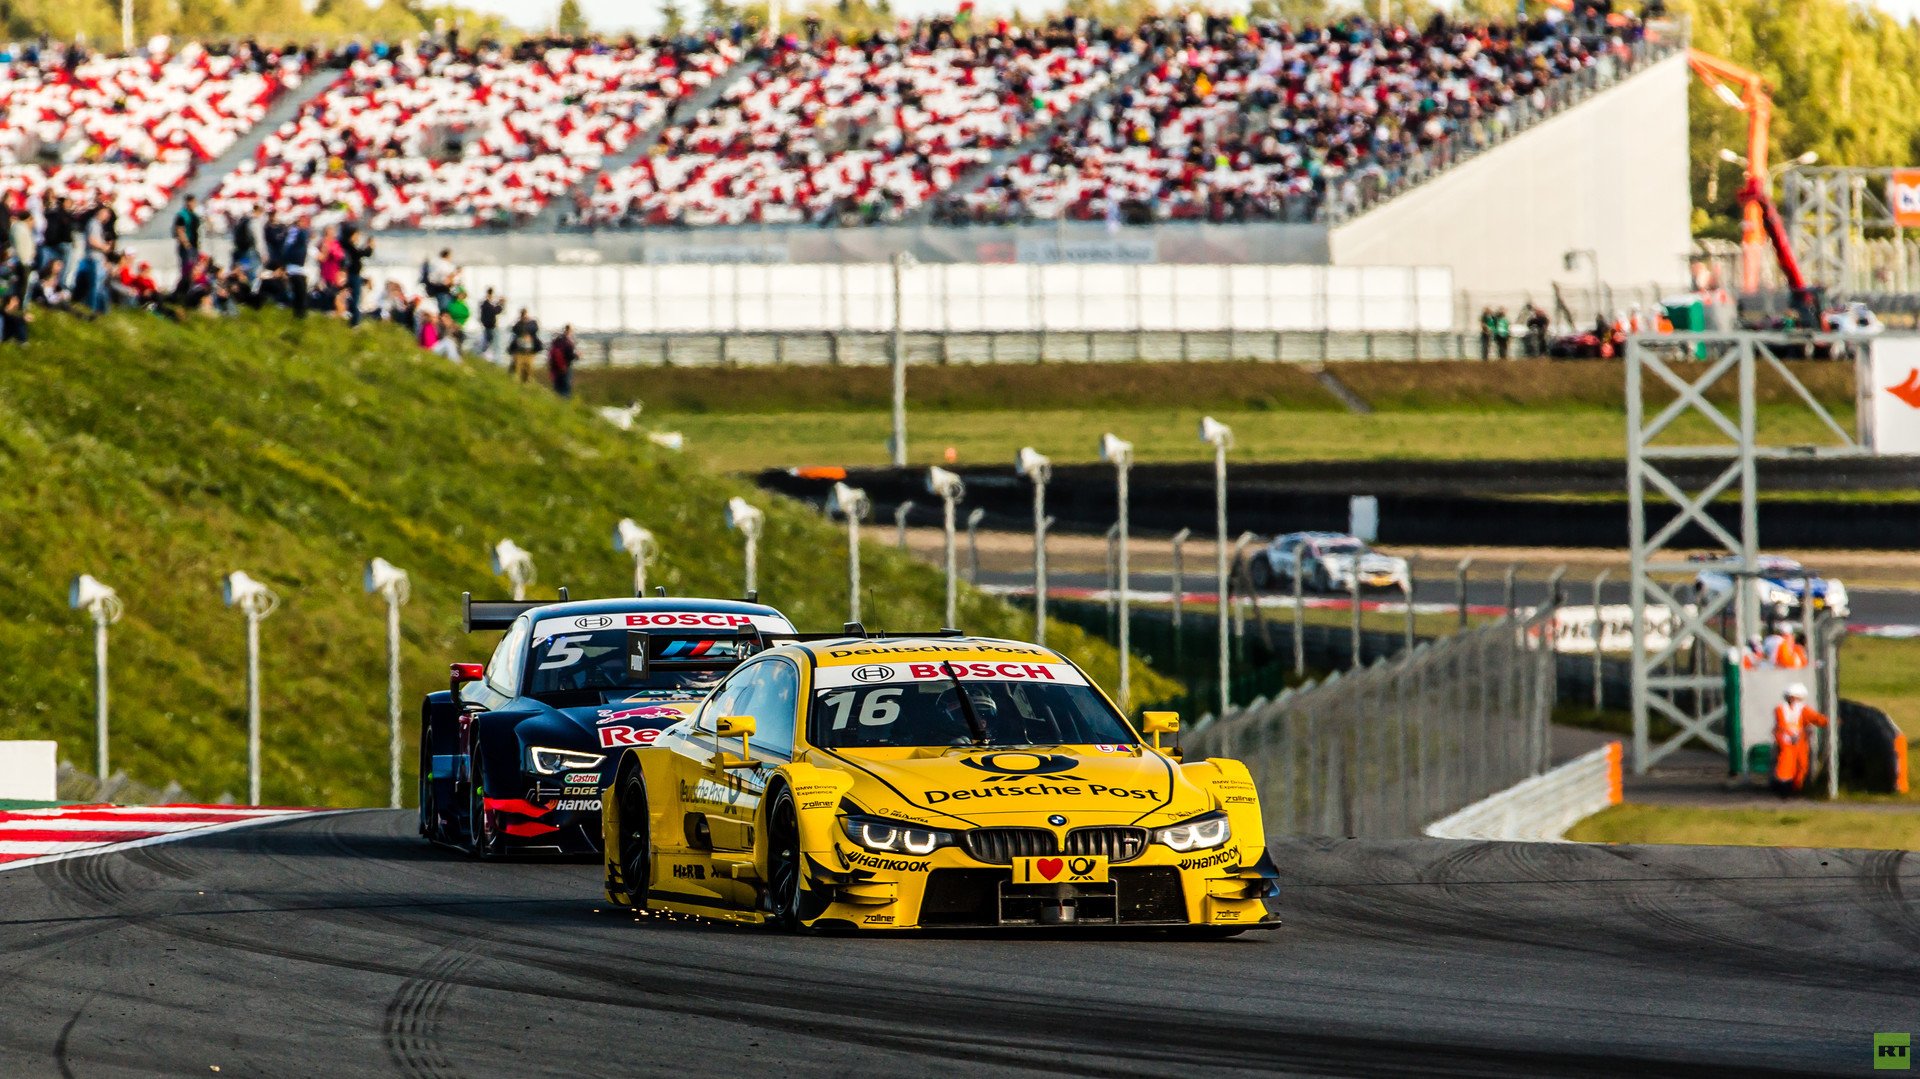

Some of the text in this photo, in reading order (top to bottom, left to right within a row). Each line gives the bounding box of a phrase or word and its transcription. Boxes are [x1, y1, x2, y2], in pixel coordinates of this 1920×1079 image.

[625, 614, 751, 627] BOSCH
[538, 635, 593, 670] 5
[830, 645, 1043, 659] Deutsche Post
[909, 663, 1056, 680] BOSCH
[825, 688, 904, 730] 16
[572, 774, 599, 783] Castrol
[563, 786, 599, 795] EDGE
[924, 783, 1162, 804] Deutsche Post
[556, 799, 603, 811] Hanko
[1025, 858, 1030, 881] I
